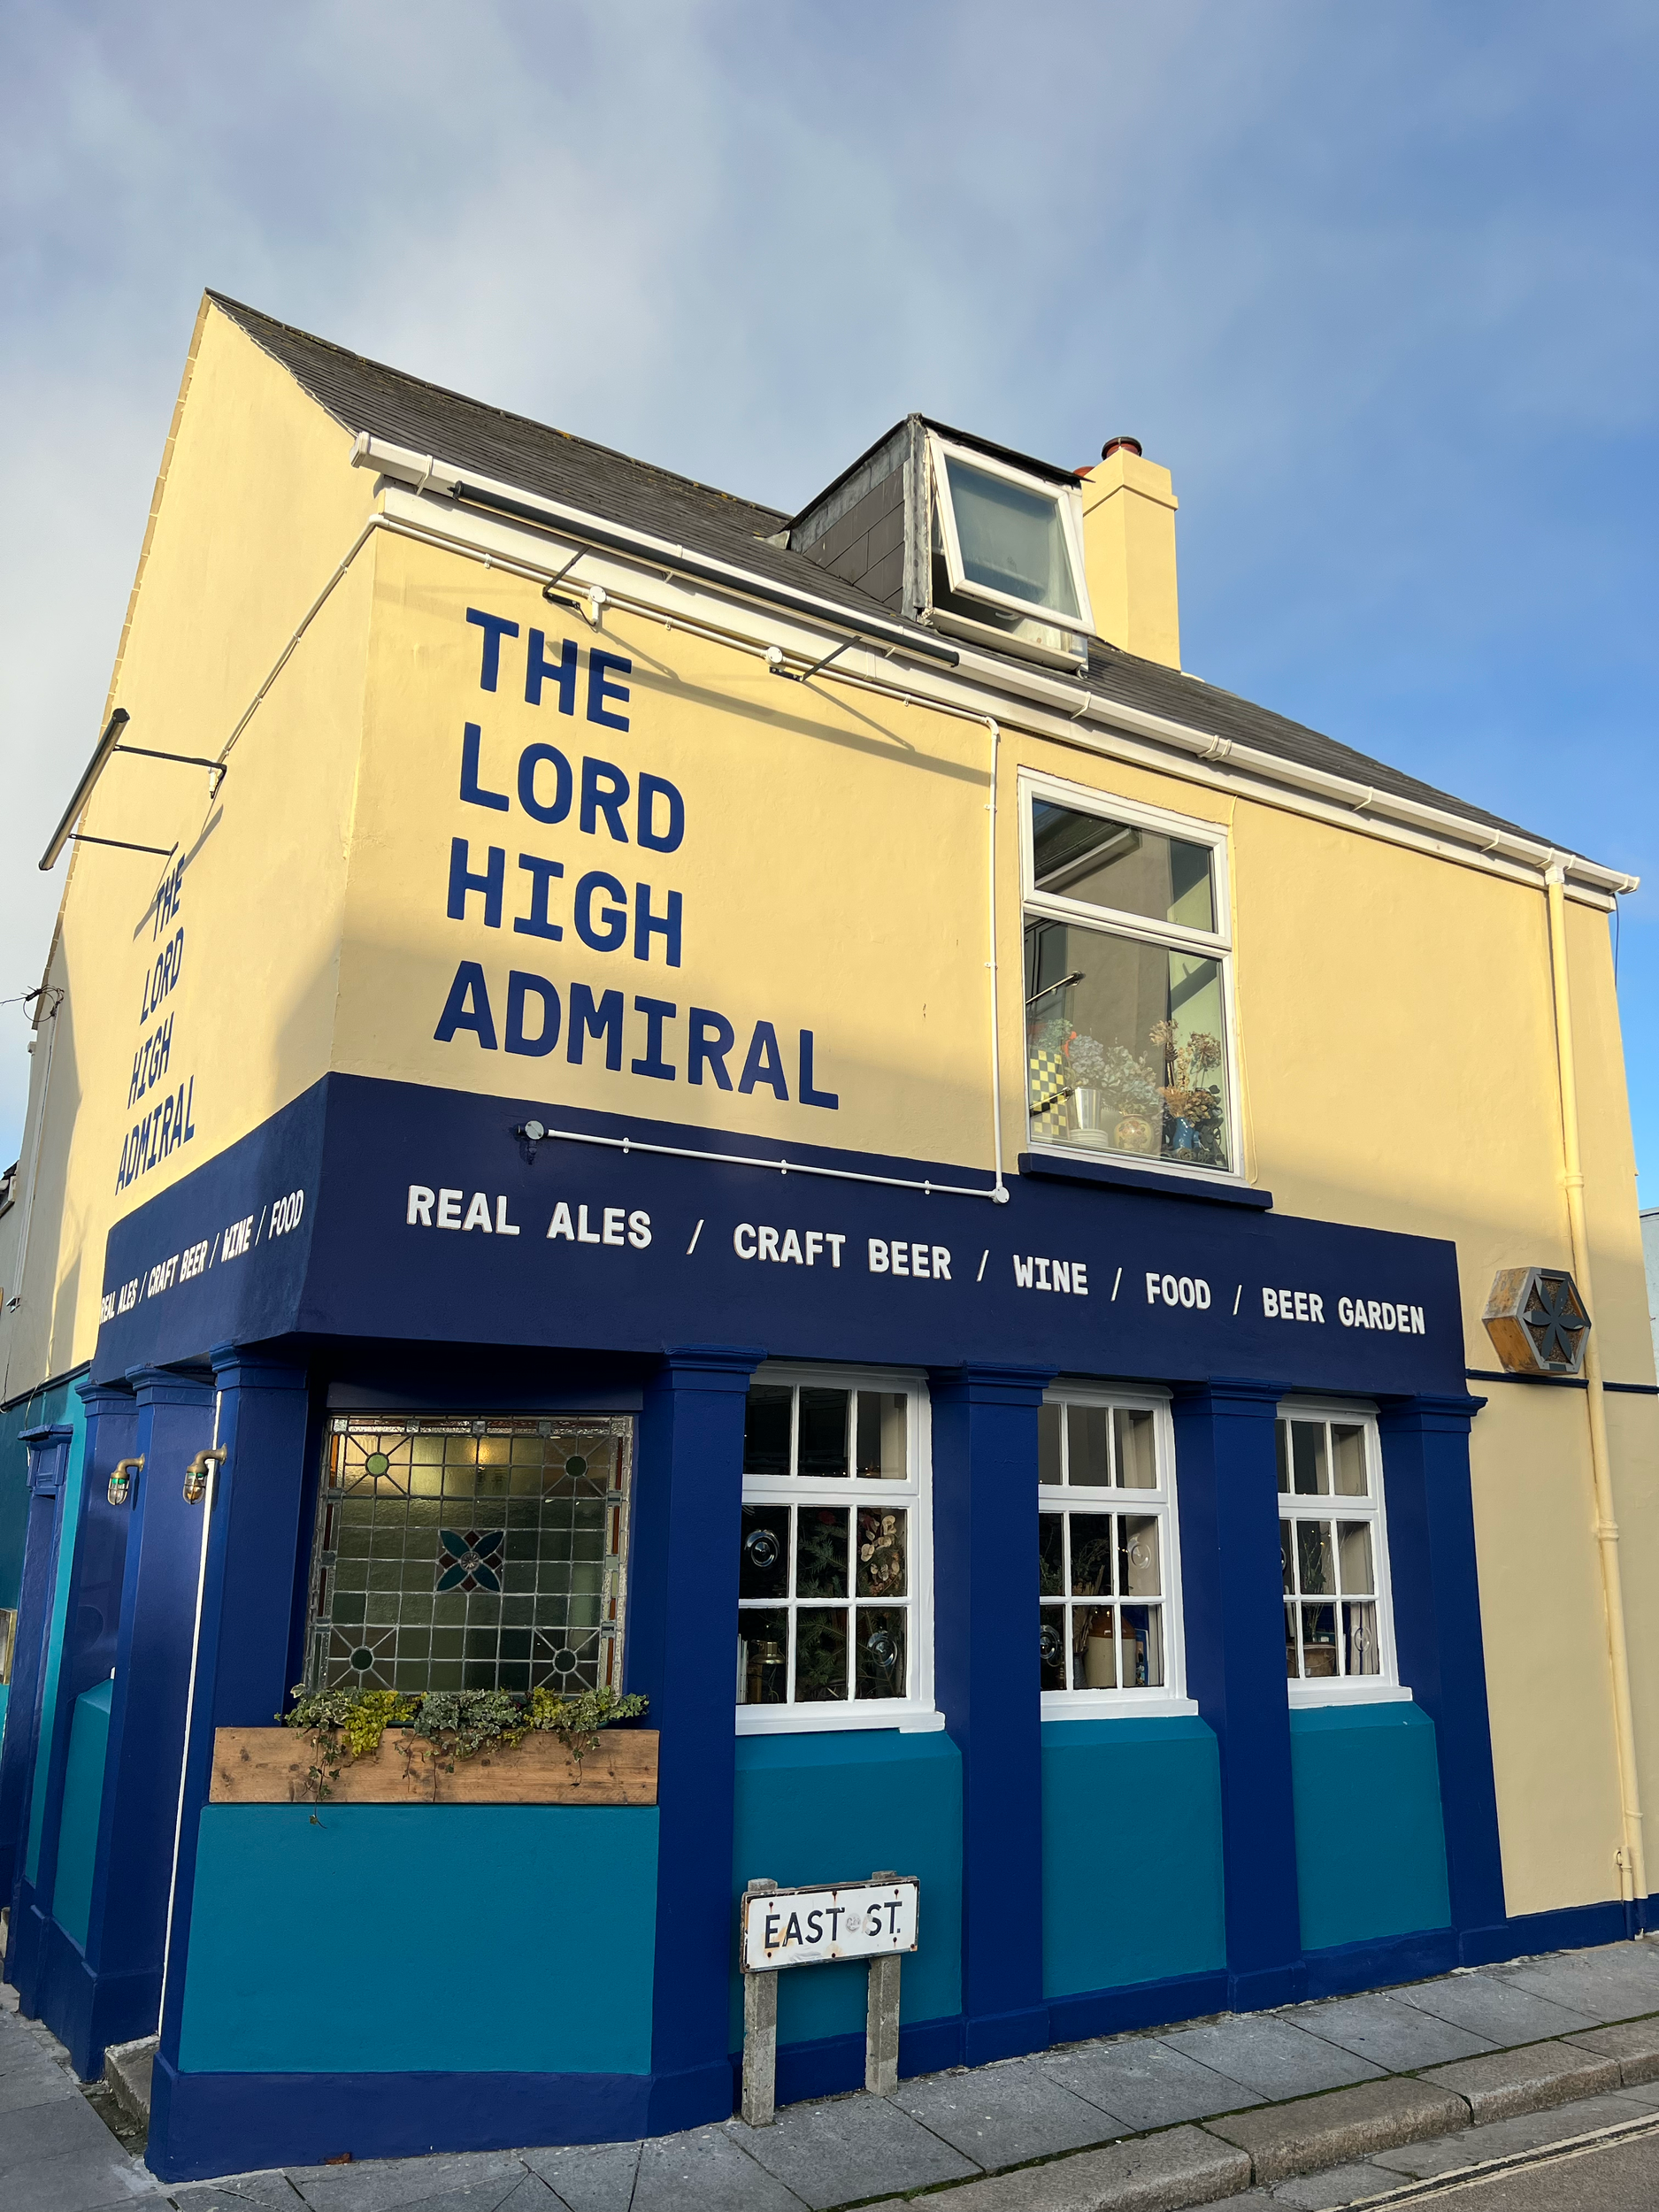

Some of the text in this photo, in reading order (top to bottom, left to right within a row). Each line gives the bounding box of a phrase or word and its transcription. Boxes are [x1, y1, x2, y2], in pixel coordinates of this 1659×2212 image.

[465, 607, 632, 732] THE
[459, 721, 685, 853] LORD
[152, 854, 185, 941] THE
[447, 837, 683, 968] HIGH
[140, 926, 184, 1025] LORD
[433, 960, 840, 1110] ADMIRAL
[127, 1011, 174, 1110] HIGH
[115, 1075, 195, 1195] ADMIRAL
[99, 1189, 304, 1325] REAL ALES / CRAFT BEER / WINE / FOOD
[406, 1184, 1425, 1335] REAL ALES / CRAFT BEER / WINE / FOOD / BEER GARDEN
[764, 1907, 845, 1948] EAST
[866, 1901, 902, 1936] ST.
